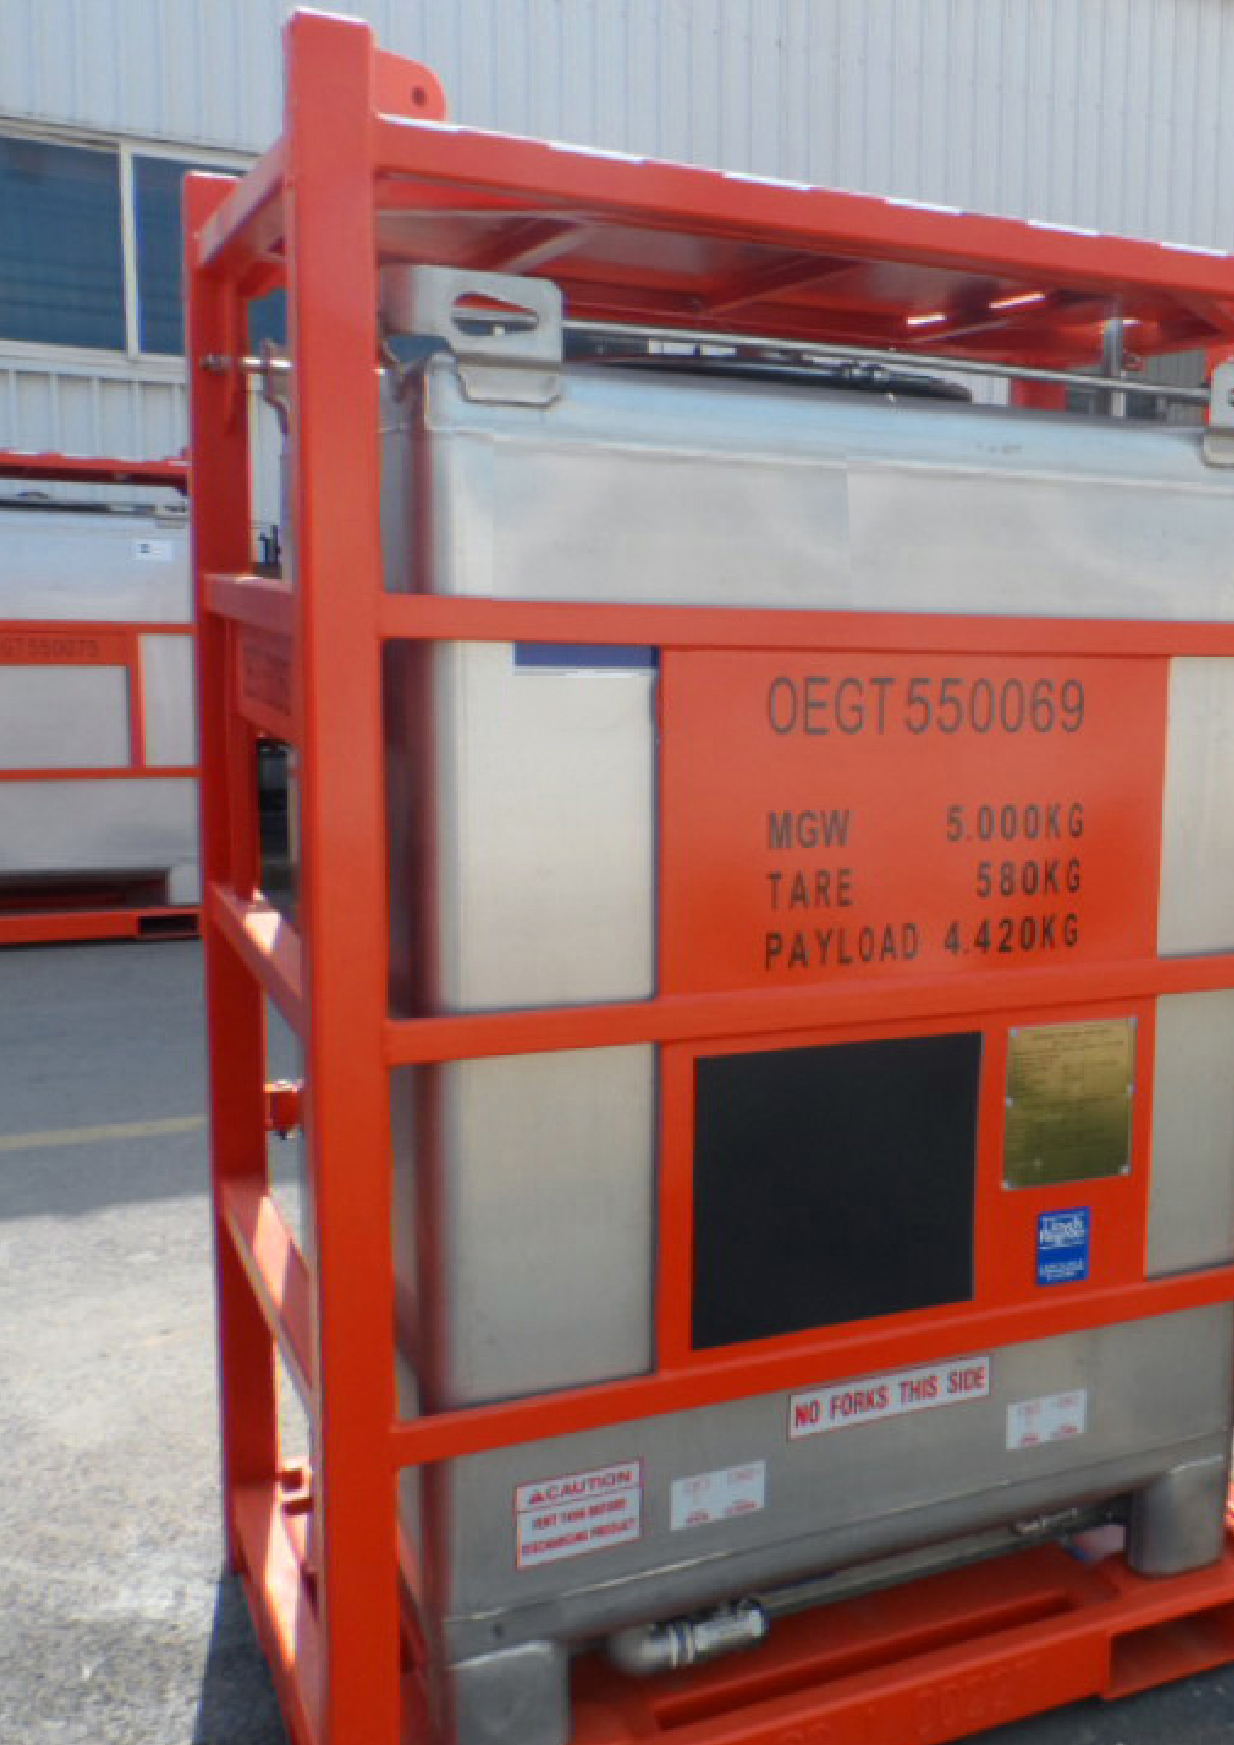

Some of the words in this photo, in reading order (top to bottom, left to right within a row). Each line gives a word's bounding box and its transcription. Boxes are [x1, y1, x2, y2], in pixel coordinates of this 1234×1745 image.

[768, 676, 1085, 735] OEGT550069
[768, 809, 850, 849] MGW
[945, 803, 1085, 843] 5.000KG
[765, 868, 853, 910] TARE
[976, 858, 1081, 898] 580KG
[765, 922, 919, 971] PAYLOAD
[944, 914, 1080, 956] 4.420KG
[794, 1402, 821, 1427] NO
[829, 1386, 890, 1420] FORKS
[900, 1376, 938, 1404] THIS
[947, 1366, 986, 1394] SIDE
[545, 1471, 631, 1500] CAUTION
